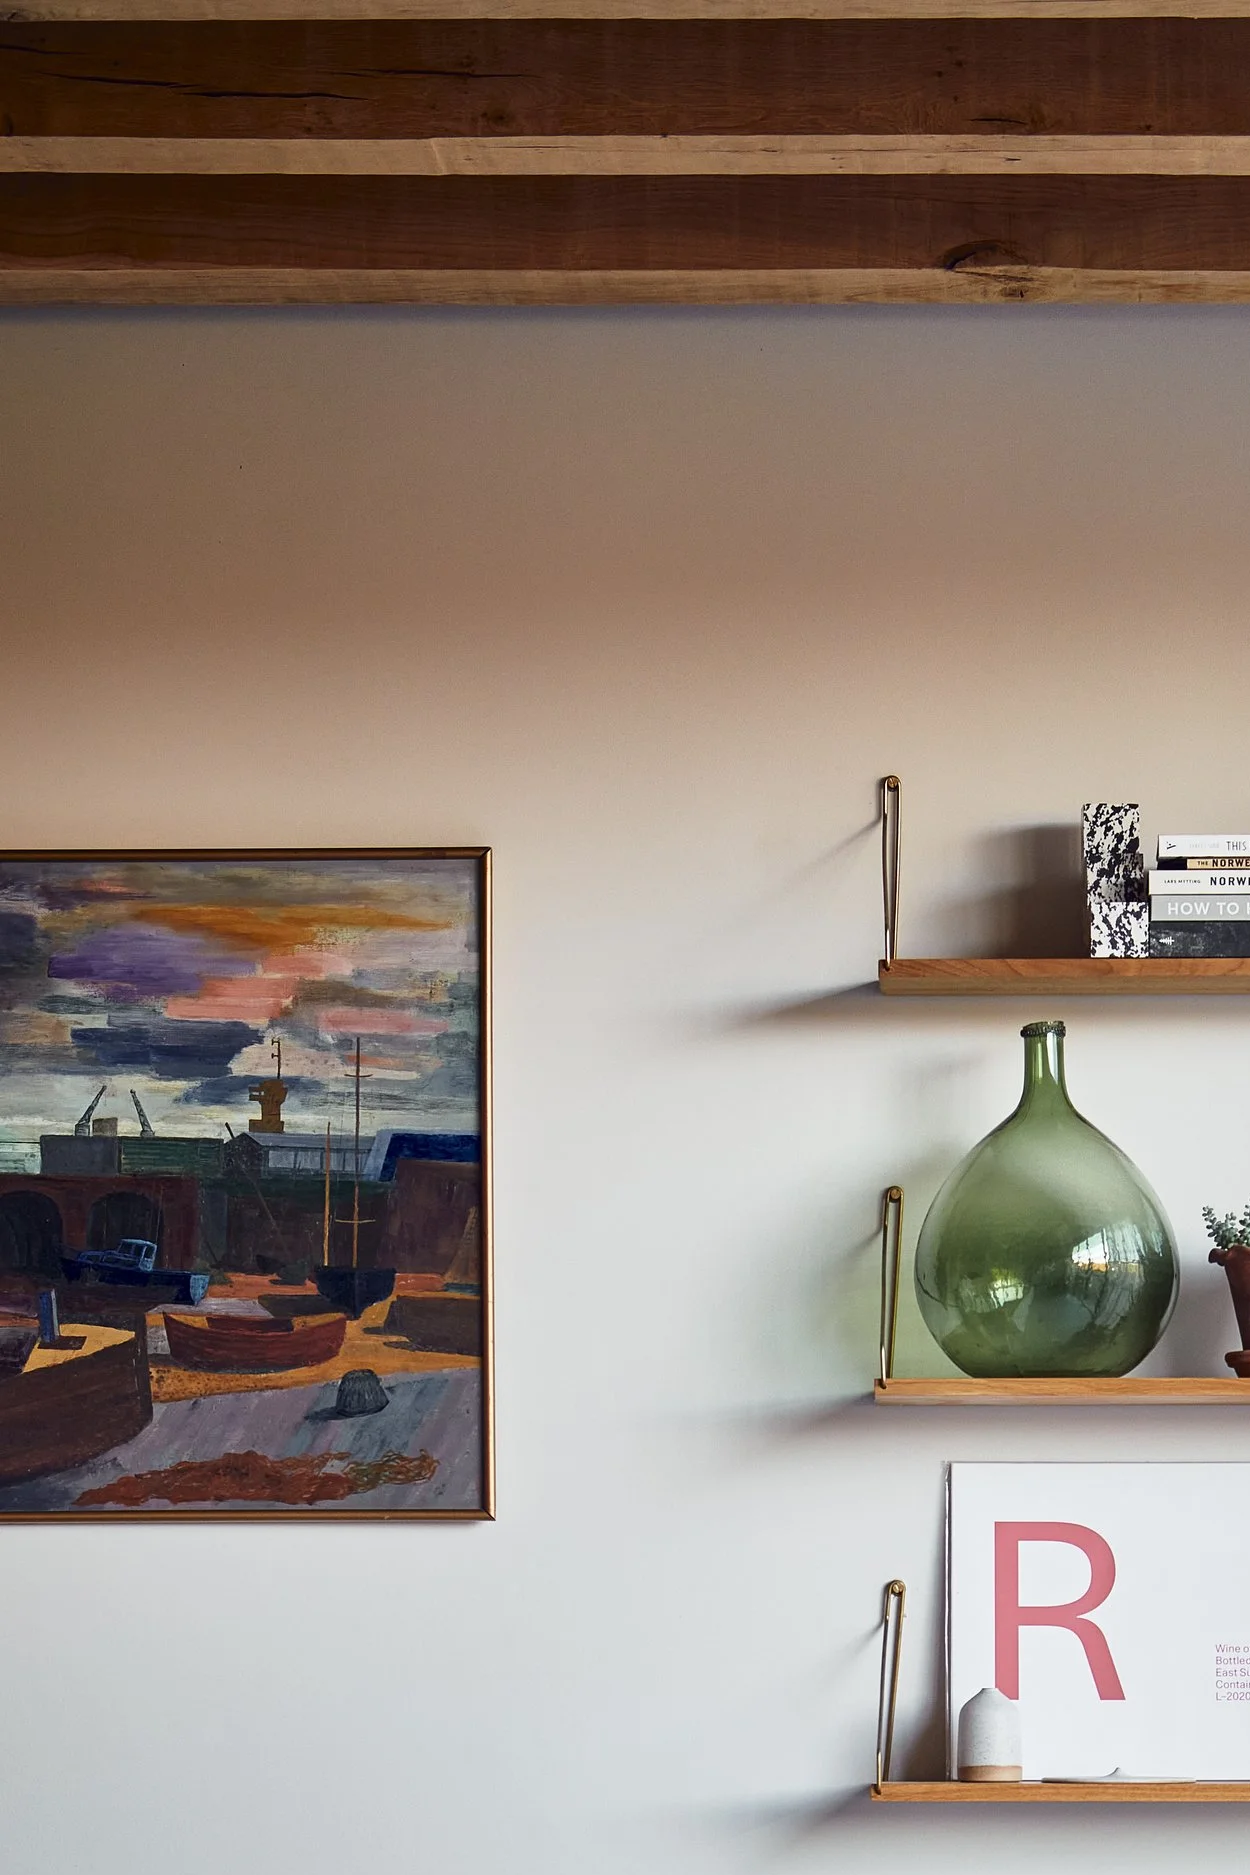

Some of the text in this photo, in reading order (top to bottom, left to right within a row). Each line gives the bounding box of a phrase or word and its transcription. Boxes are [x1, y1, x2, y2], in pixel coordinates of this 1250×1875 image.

[1226, 841, 1247, 851] THIS
[1167, 902, 1210, 915] HOW
[1216, 902, 1240, 915] TO
[994, 1521, 1126, 1701] R
[1215, 1644, 1241, 1653] Wine
[1215, 1668, 1238, 1677] East
